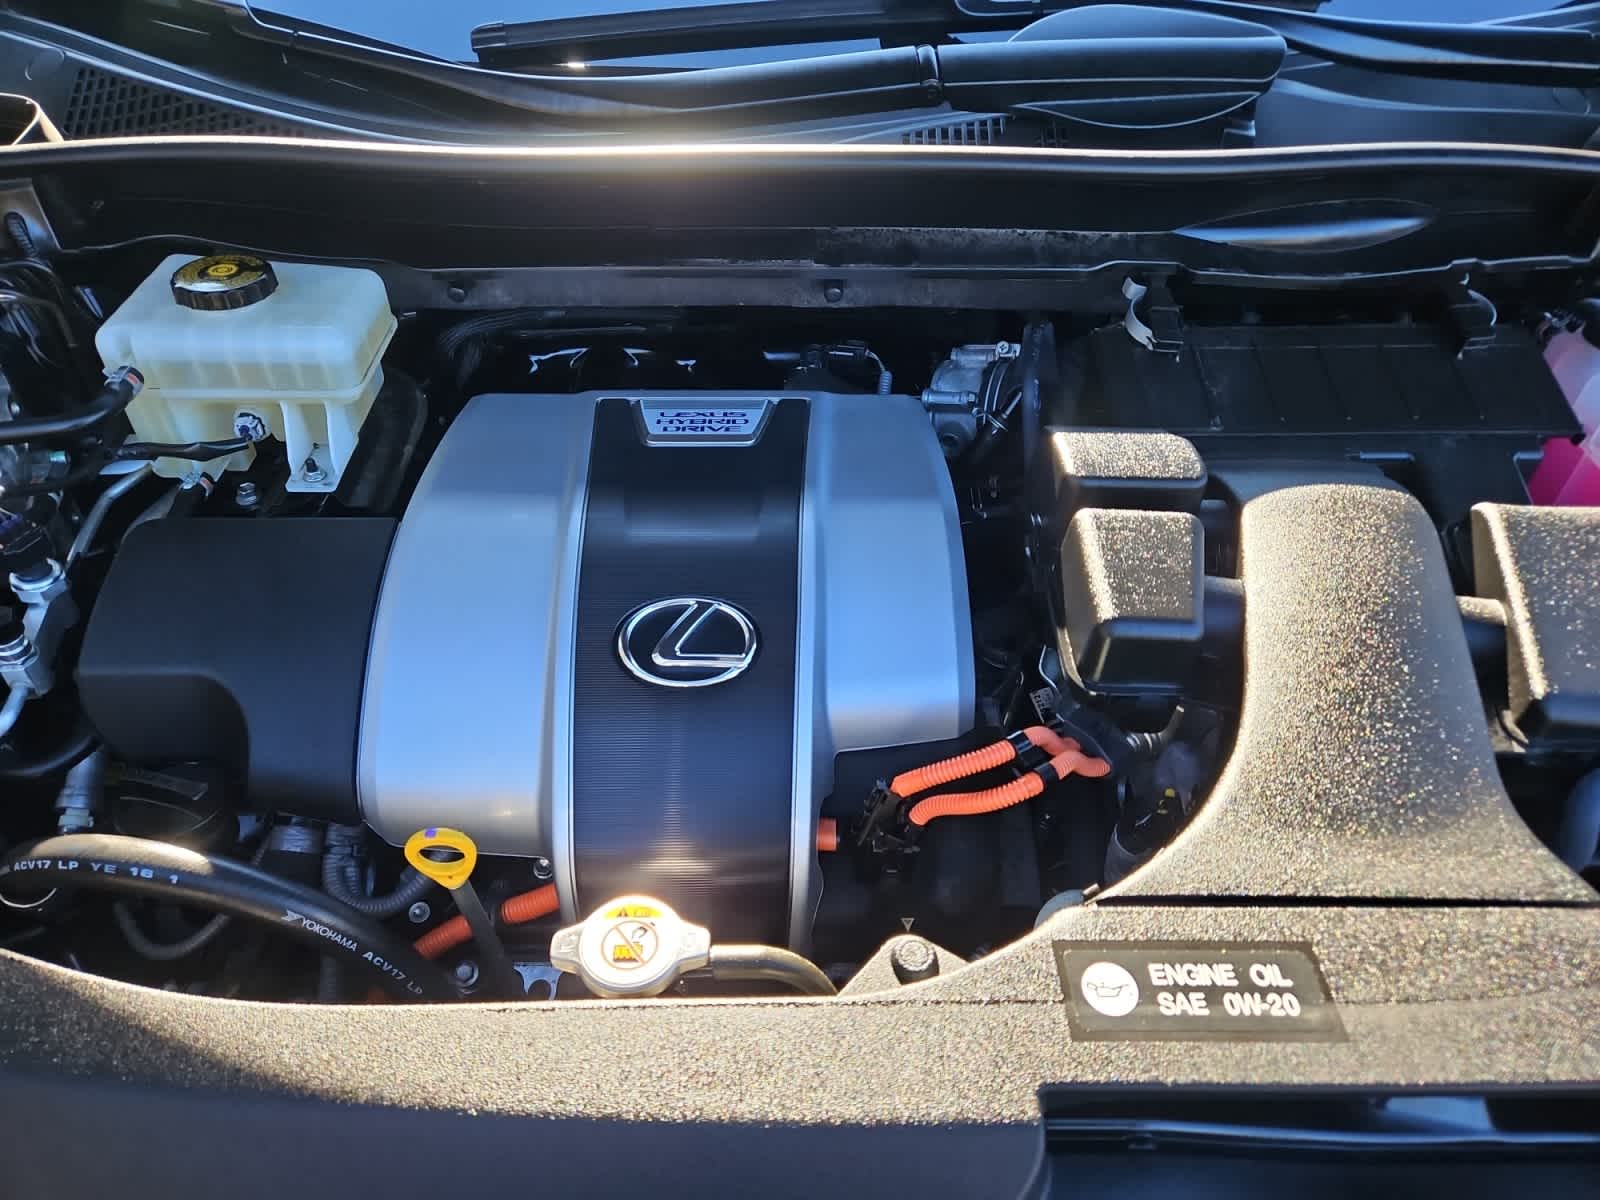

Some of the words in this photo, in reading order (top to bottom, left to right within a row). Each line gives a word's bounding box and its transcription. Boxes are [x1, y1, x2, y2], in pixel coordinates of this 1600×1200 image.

[14, 859, 52, 871] ACV17
[58, 860, 80, 870] LP
[90, 862, 117, 875] YE
[169, 874, 180, 885] 1
[301, 917, 359, 951] YOKOHAMA
[362, 951, 407, 980] ACV17
[407, 981, 423, 995] LP
[1148, 963, 1239, 987] ENGINE
[1249, 963, 1294, 988] OIL
[1157, 991, 1210, 1016] SAE
[1223, 992, 1301, 1017] 0W-20
